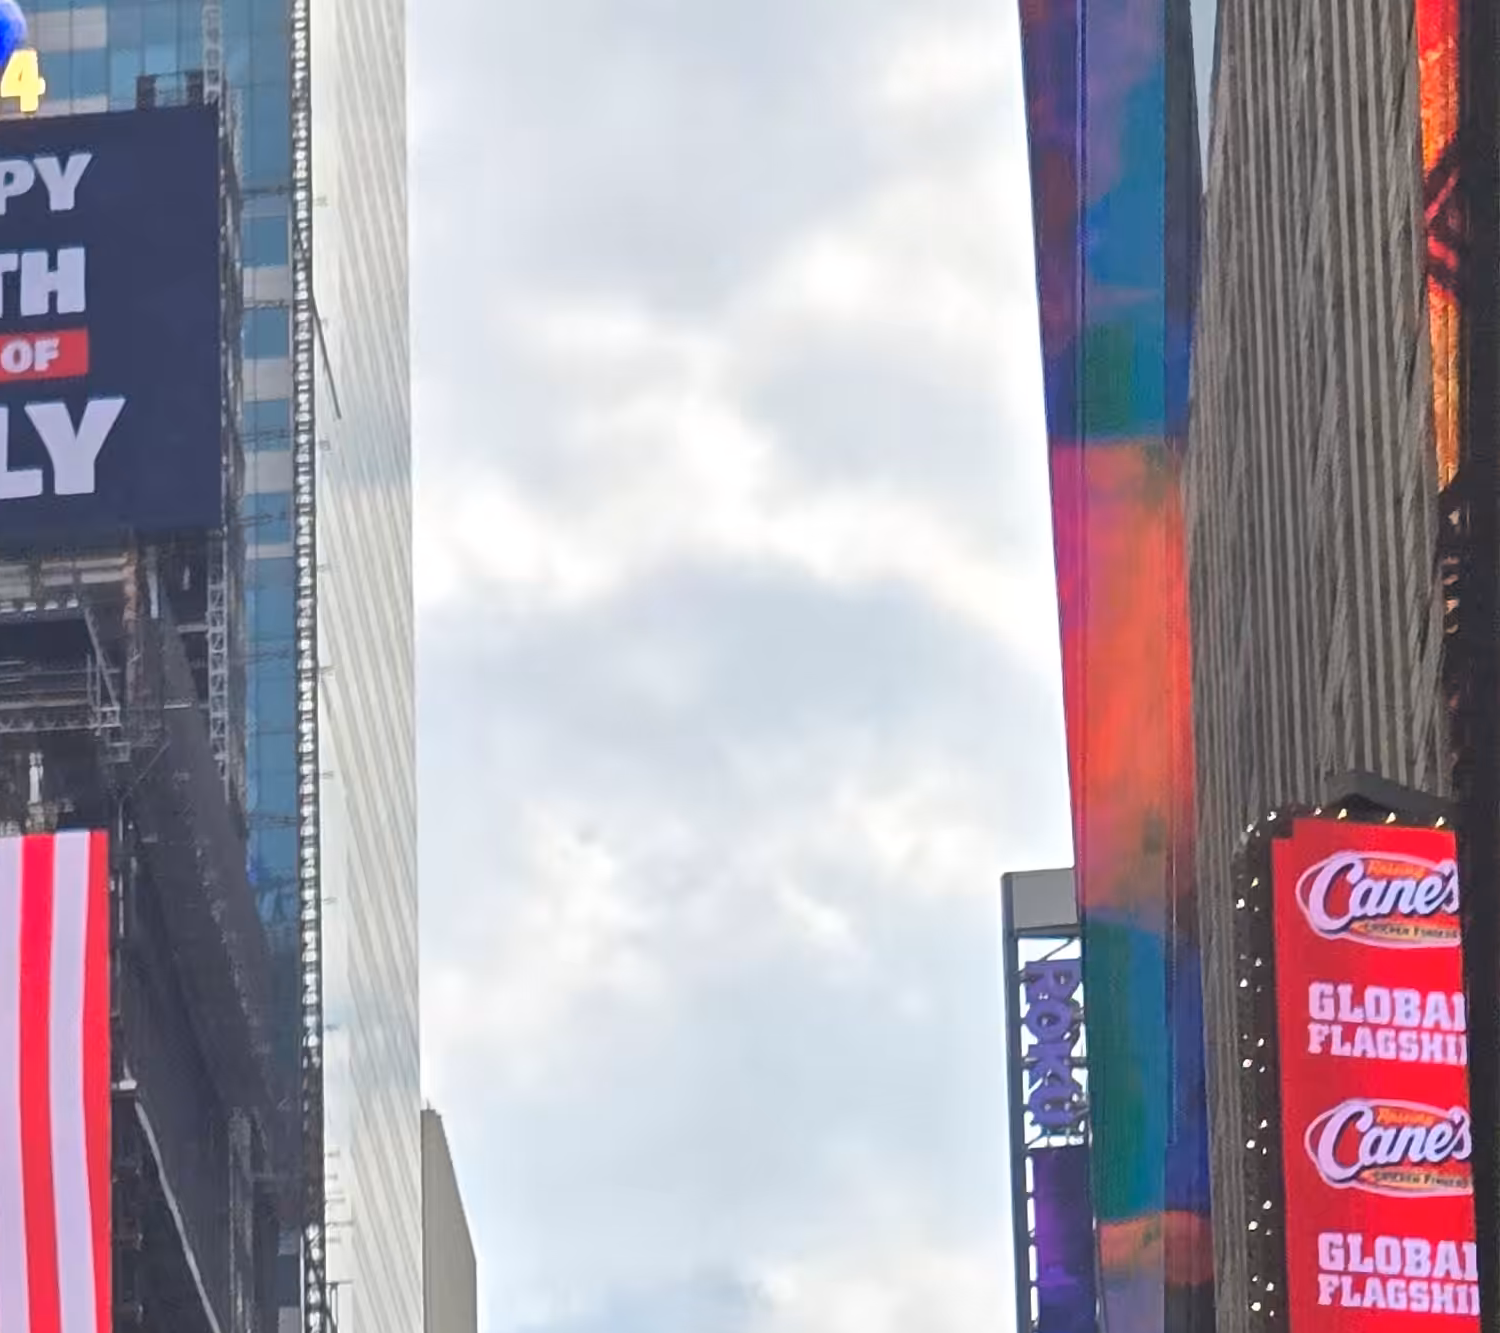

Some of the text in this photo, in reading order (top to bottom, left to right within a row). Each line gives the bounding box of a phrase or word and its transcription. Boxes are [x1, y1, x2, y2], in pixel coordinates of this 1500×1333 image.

[0, 337, 60, 373] OF
[1309, 852, 1460, 930] Cane's
[1318, 1101, 1472, 1181] Cane's
